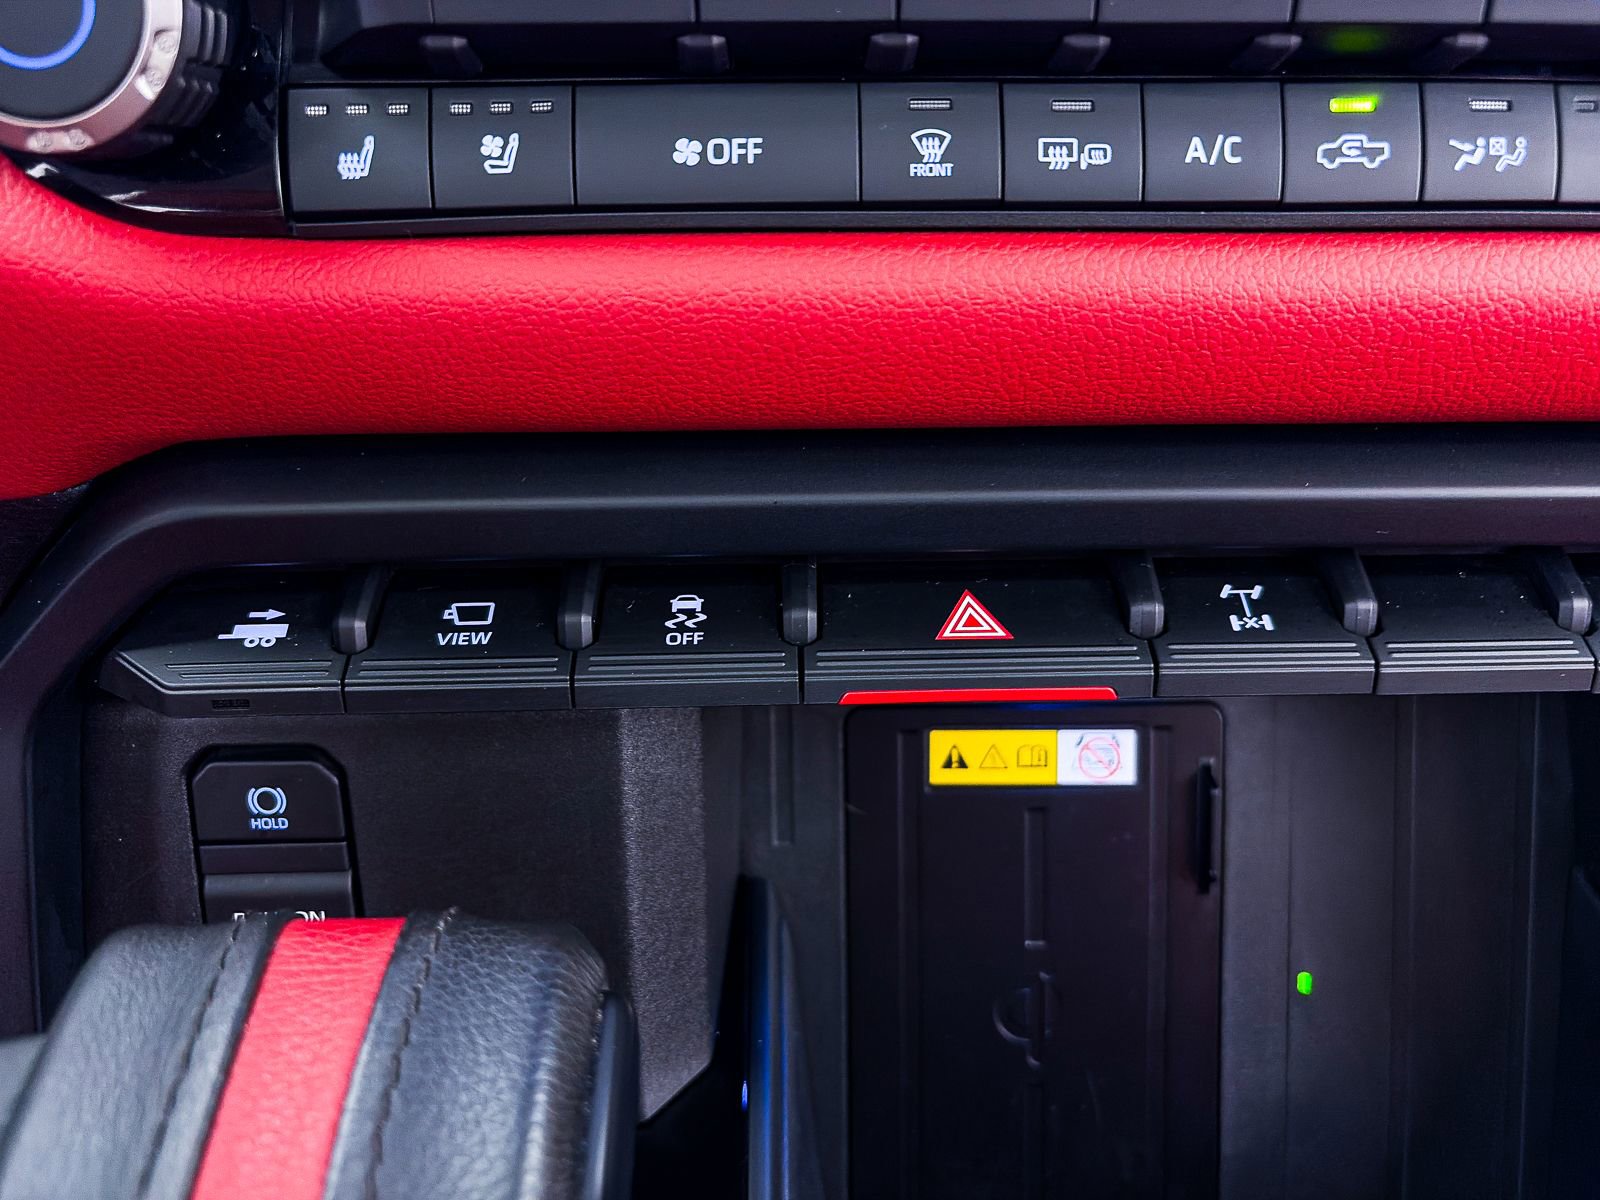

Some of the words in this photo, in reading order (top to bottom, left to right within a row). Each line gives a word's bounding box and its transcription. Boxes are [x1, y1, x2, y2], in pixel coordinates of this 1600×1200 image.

[706, 137, 764, 166] OFF
[1184, 133, 1244, 166] A/C
[909, 162, 955, 177] FRONT
[437, 631, 493, 646] VIEW
[665, 632, 705, 646] OFF
[250, 817, 289, 830] HOLD
